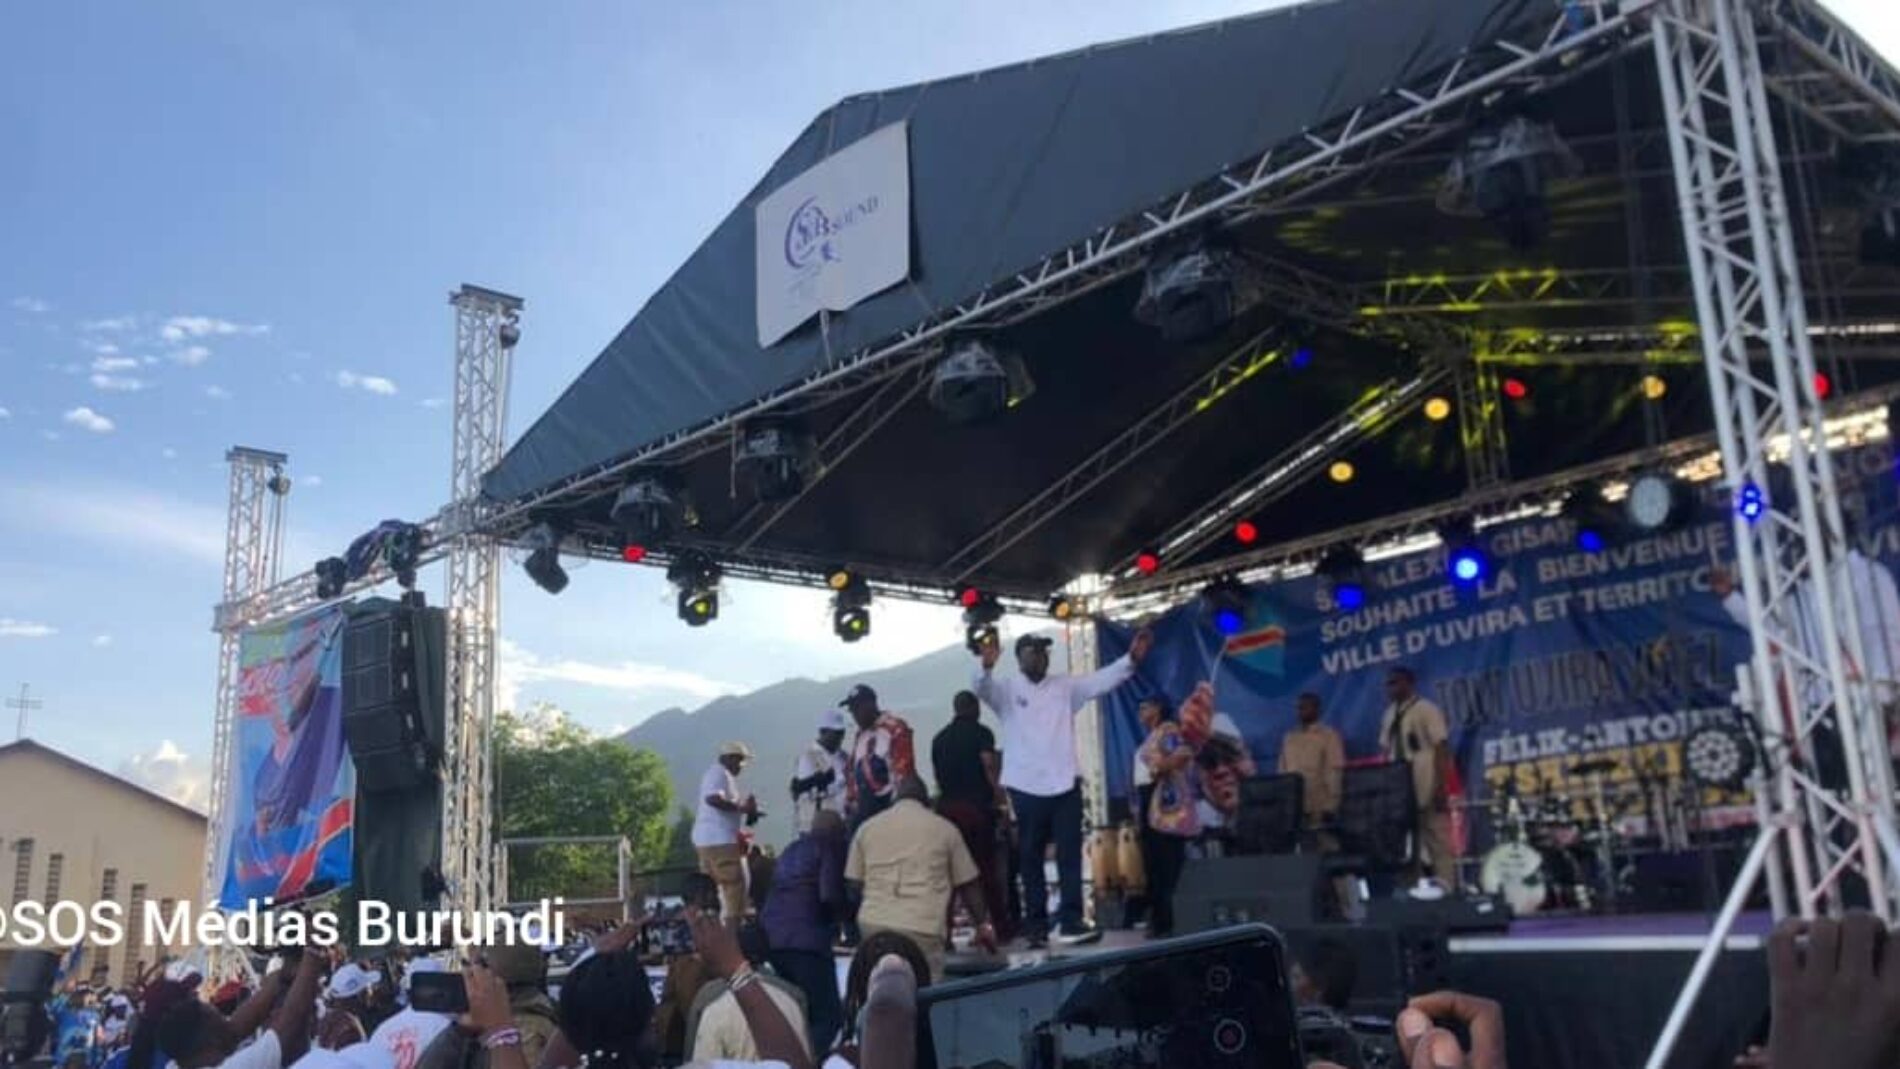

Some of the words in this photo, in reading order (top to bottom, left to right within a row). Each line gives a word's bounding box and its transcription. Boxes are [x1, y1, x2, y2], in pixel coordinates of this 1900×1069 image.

[1320, 584, 1458, 643] SOUHAITE
[1477, 568, 1516, 599] LA
[1538, 522, 1729, 583] BIENVENUE
[1322, 634, 1401, 675] VILLE
[1534, 590, 1573, 623] ET
